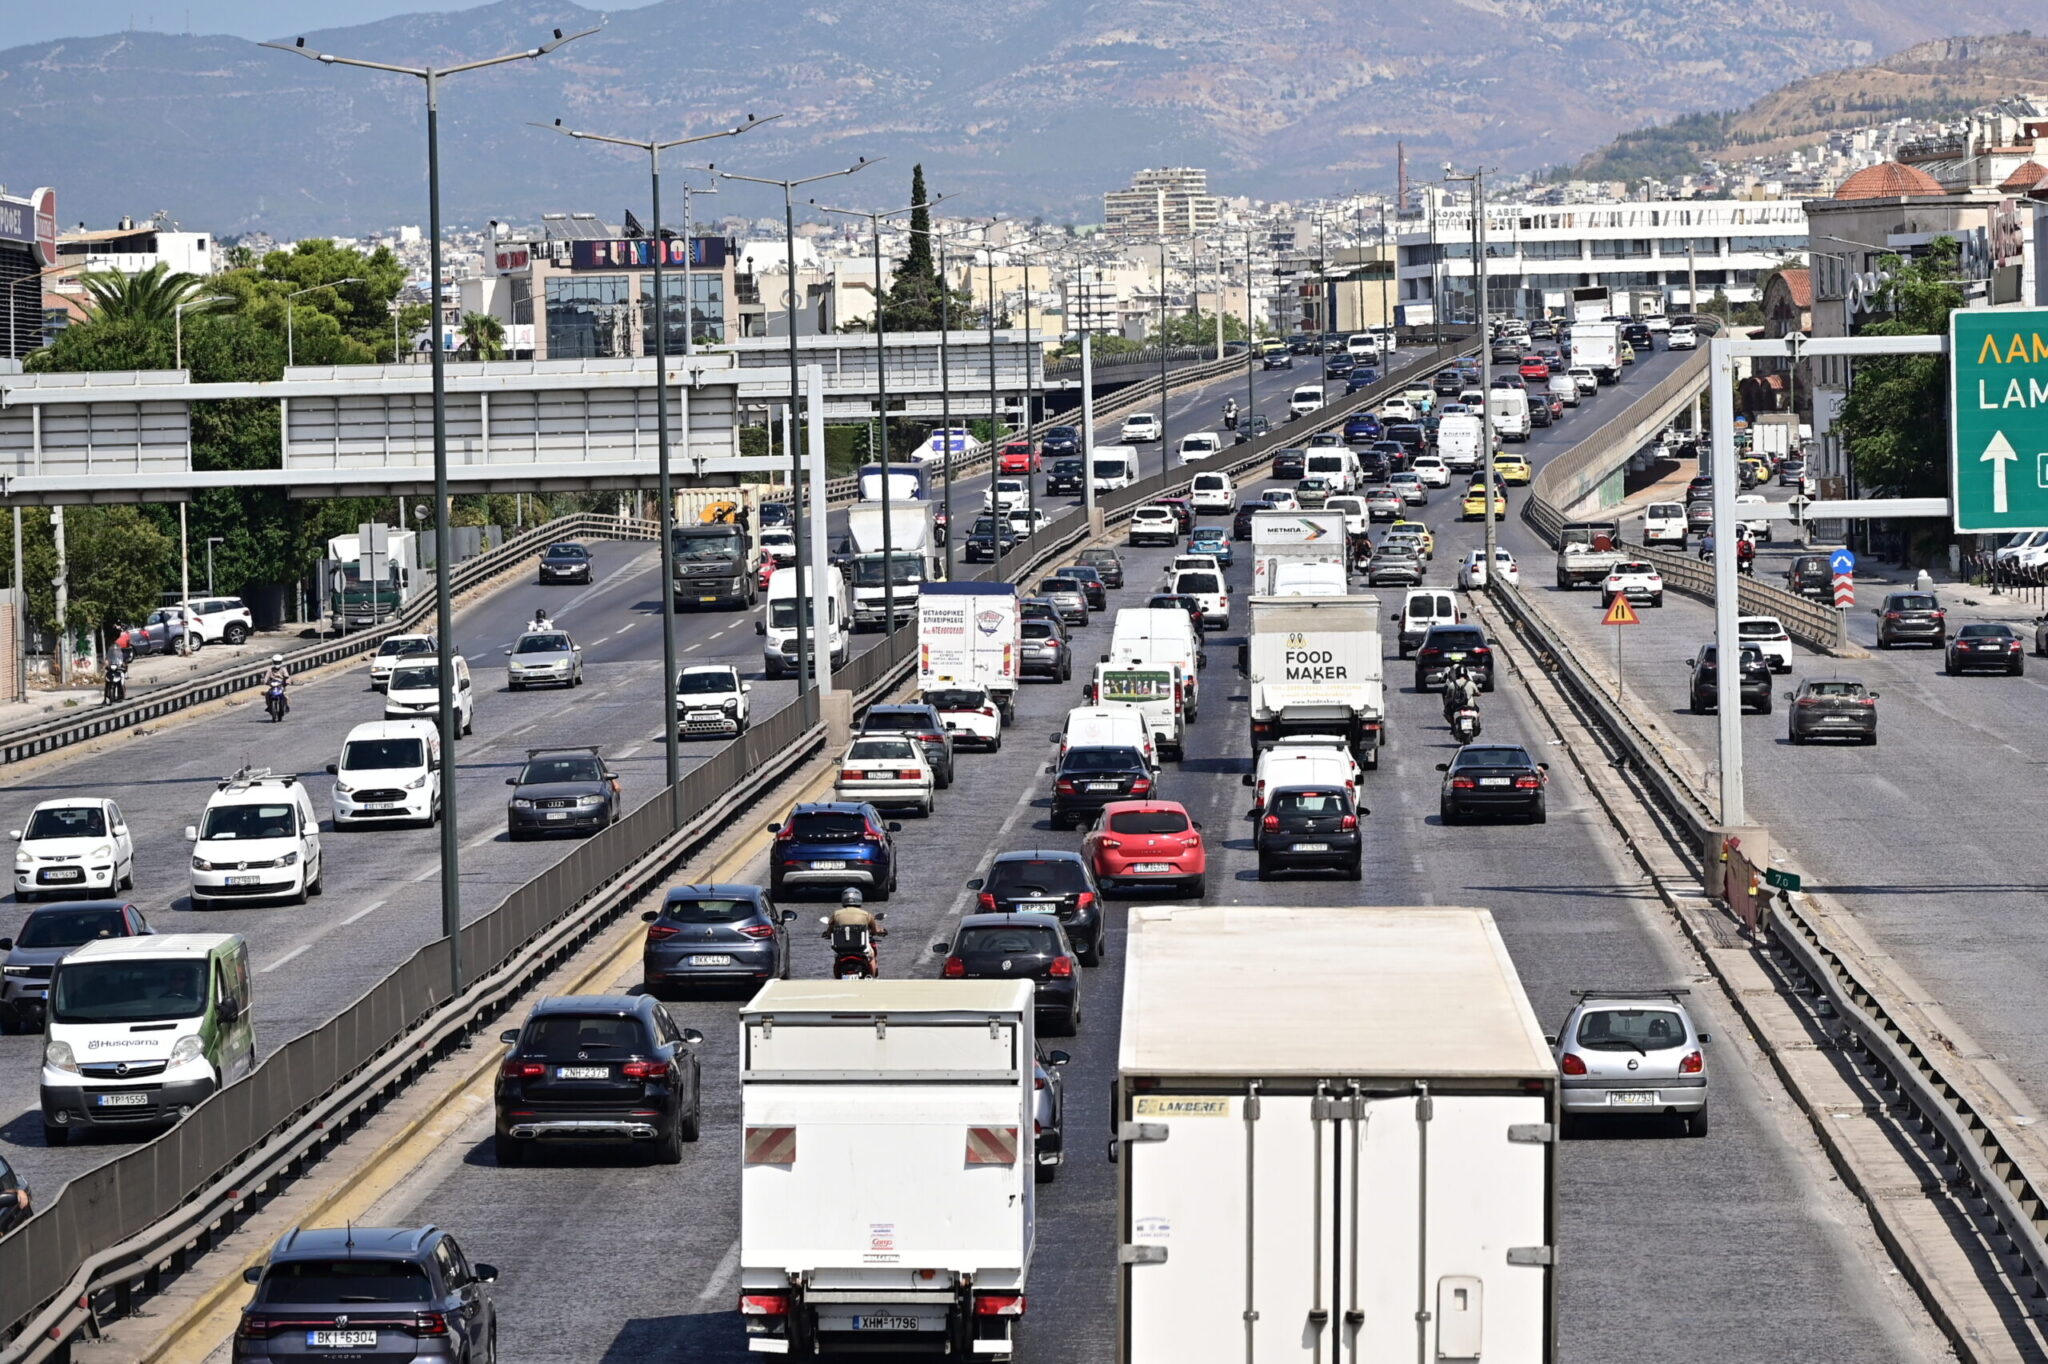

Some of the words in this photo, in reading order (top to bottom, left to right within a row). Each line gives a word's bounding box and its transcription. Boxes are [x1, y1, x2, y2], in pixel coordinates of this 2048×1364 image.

[1285, 651, 1333, 664] FOOD
[1286, 666, 1347, 680] MAKER
[1159, 1102, 1225, 1111] LAMBERET
[862, 1317, 917, 1329] XHM-1796
[317, 1331, 375, 1343] BKI-6304
